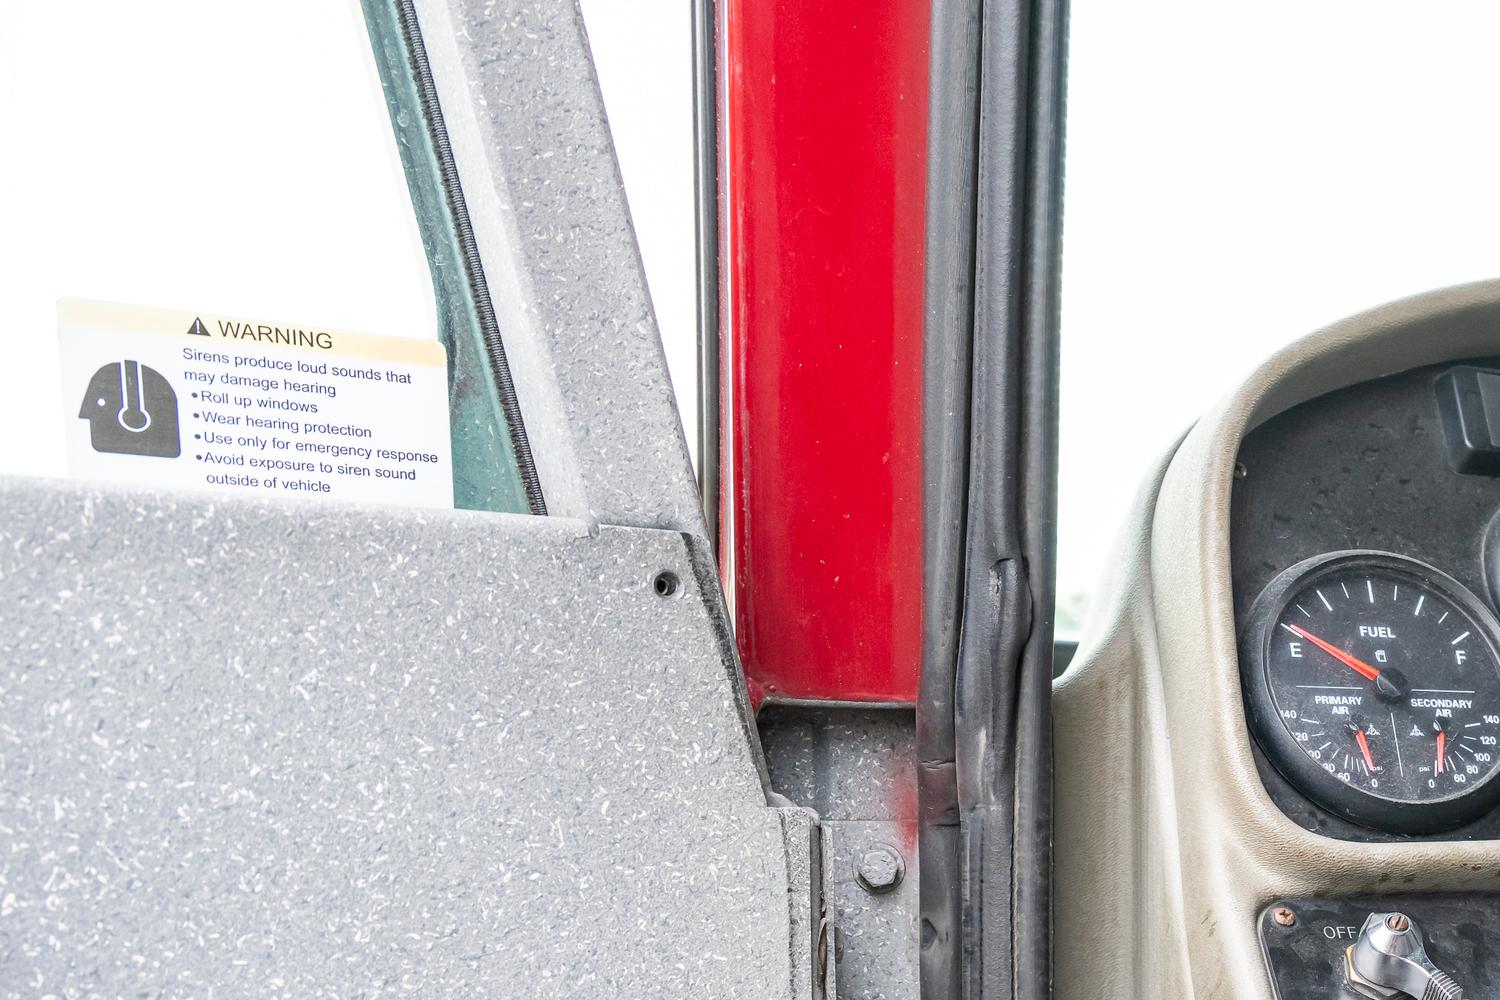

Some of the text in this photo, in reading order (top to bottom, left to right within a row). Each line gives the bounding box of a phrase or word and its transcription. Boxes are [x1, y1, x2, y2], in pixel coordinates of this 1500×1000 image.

[217, 320, 333, 350] WARNING
[183, 347, 412, 384] Sirens produce loud sounds that
[184, 371, 336, 398] may damage hearing
[201, 390, 318, 413] Roll up windows
[202, 410, 372, 438] Wear hearing protection
[204, 431, 439, 463] Use only for emergency response
[204, 452, 416, 480] Avoid exposure to siren sound
[206, 474, 331, 493] outside of vehicle
[1359, 625, 1396, 639] FUEL
[1290, 643, 1303, 658] E
[1455, 650, 1467, 665] F
[1314, 695, 1362, 705] PRIMARY
[1410, 699, 1472, 708] SECONDARY
[1332, 706, 1349, 715] AIR
[1435, 709, 1452, 718] AIR
[1483, 715, 1500, 724] 140
[1294, 732, 1308, 741] 20
[1480, 736, 1496, 745] 120
[1308, 750, 1321, 759] 00
[1474, 753, 1490, 762] 100
[1466, 765, 1479, 774] 80
[1337, 772, 1350, 782] 60
[1453, 773, 1466, 783] 60
[1371, 779, 1378, 788] 0
[1428, 779, 1435, 788] 0
[1323, 926, 1358, 939] OFF
